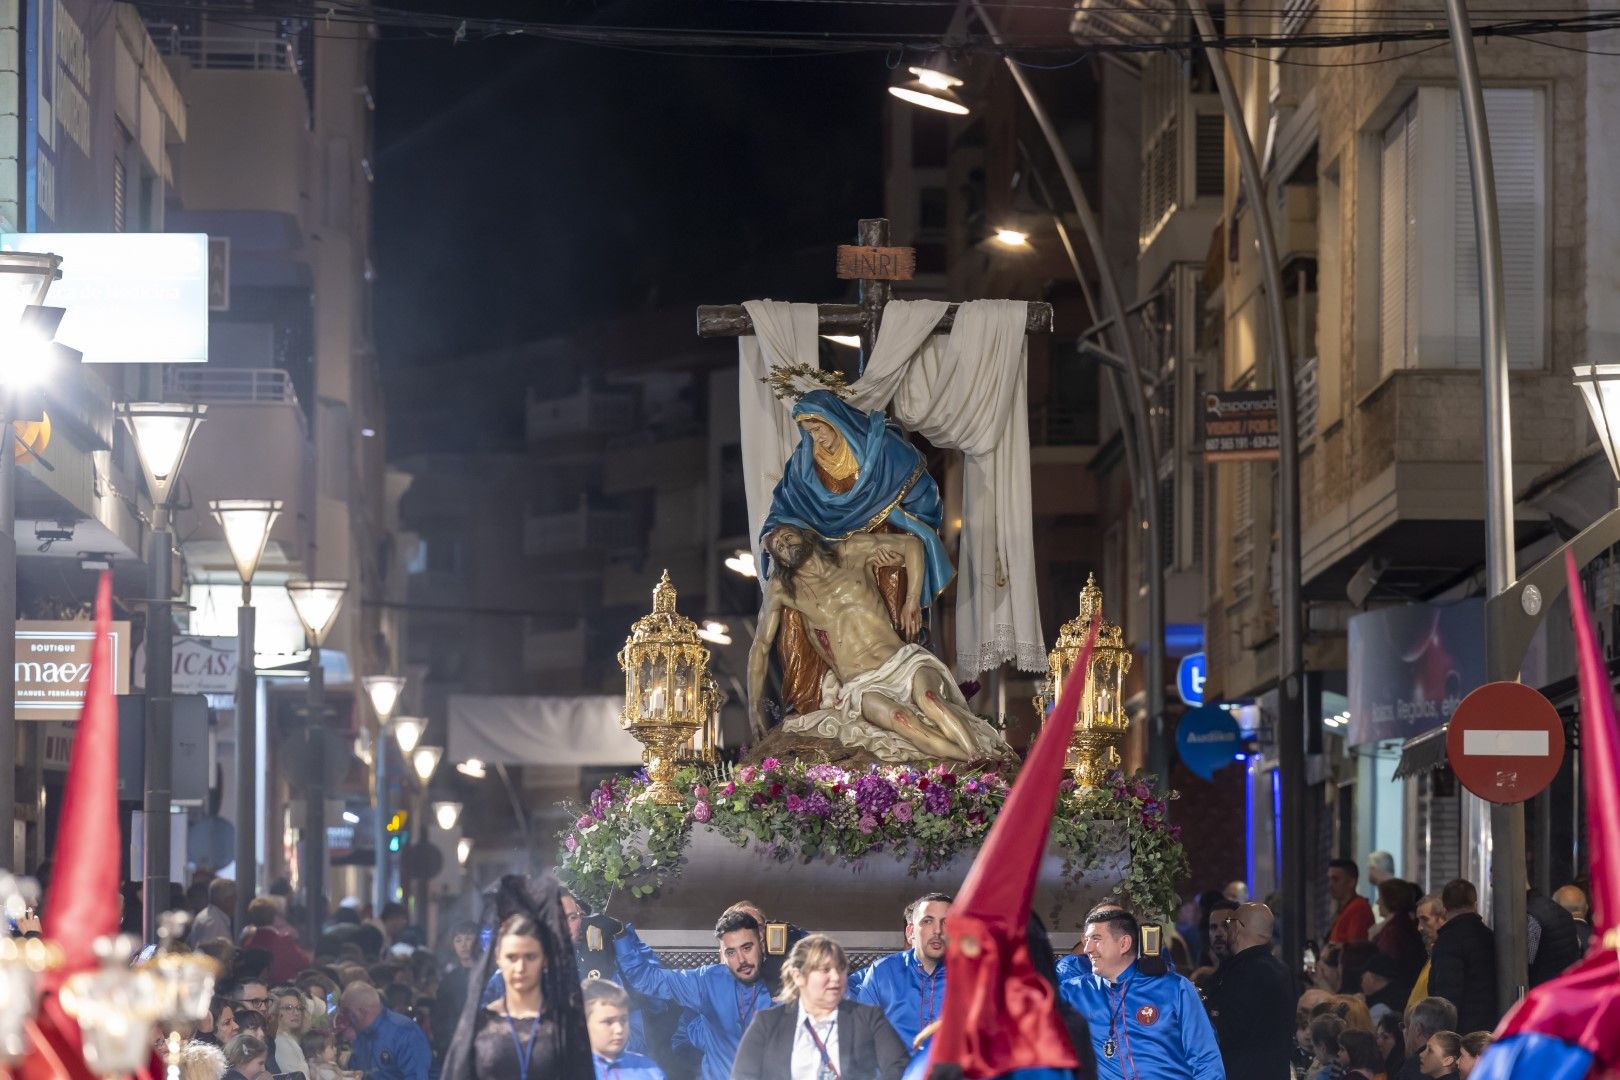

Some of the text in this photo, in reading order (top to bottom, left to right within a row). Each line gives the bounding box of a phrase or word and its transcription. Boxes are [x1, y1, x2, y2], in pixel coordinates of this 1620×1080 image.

[847, 253, 897, 277] INRI
[31, 644, 75, 653] BOUTIQUE
[15, 662, 91, 683] maez
[48, 688, 87, 697] FERNÁNDE
